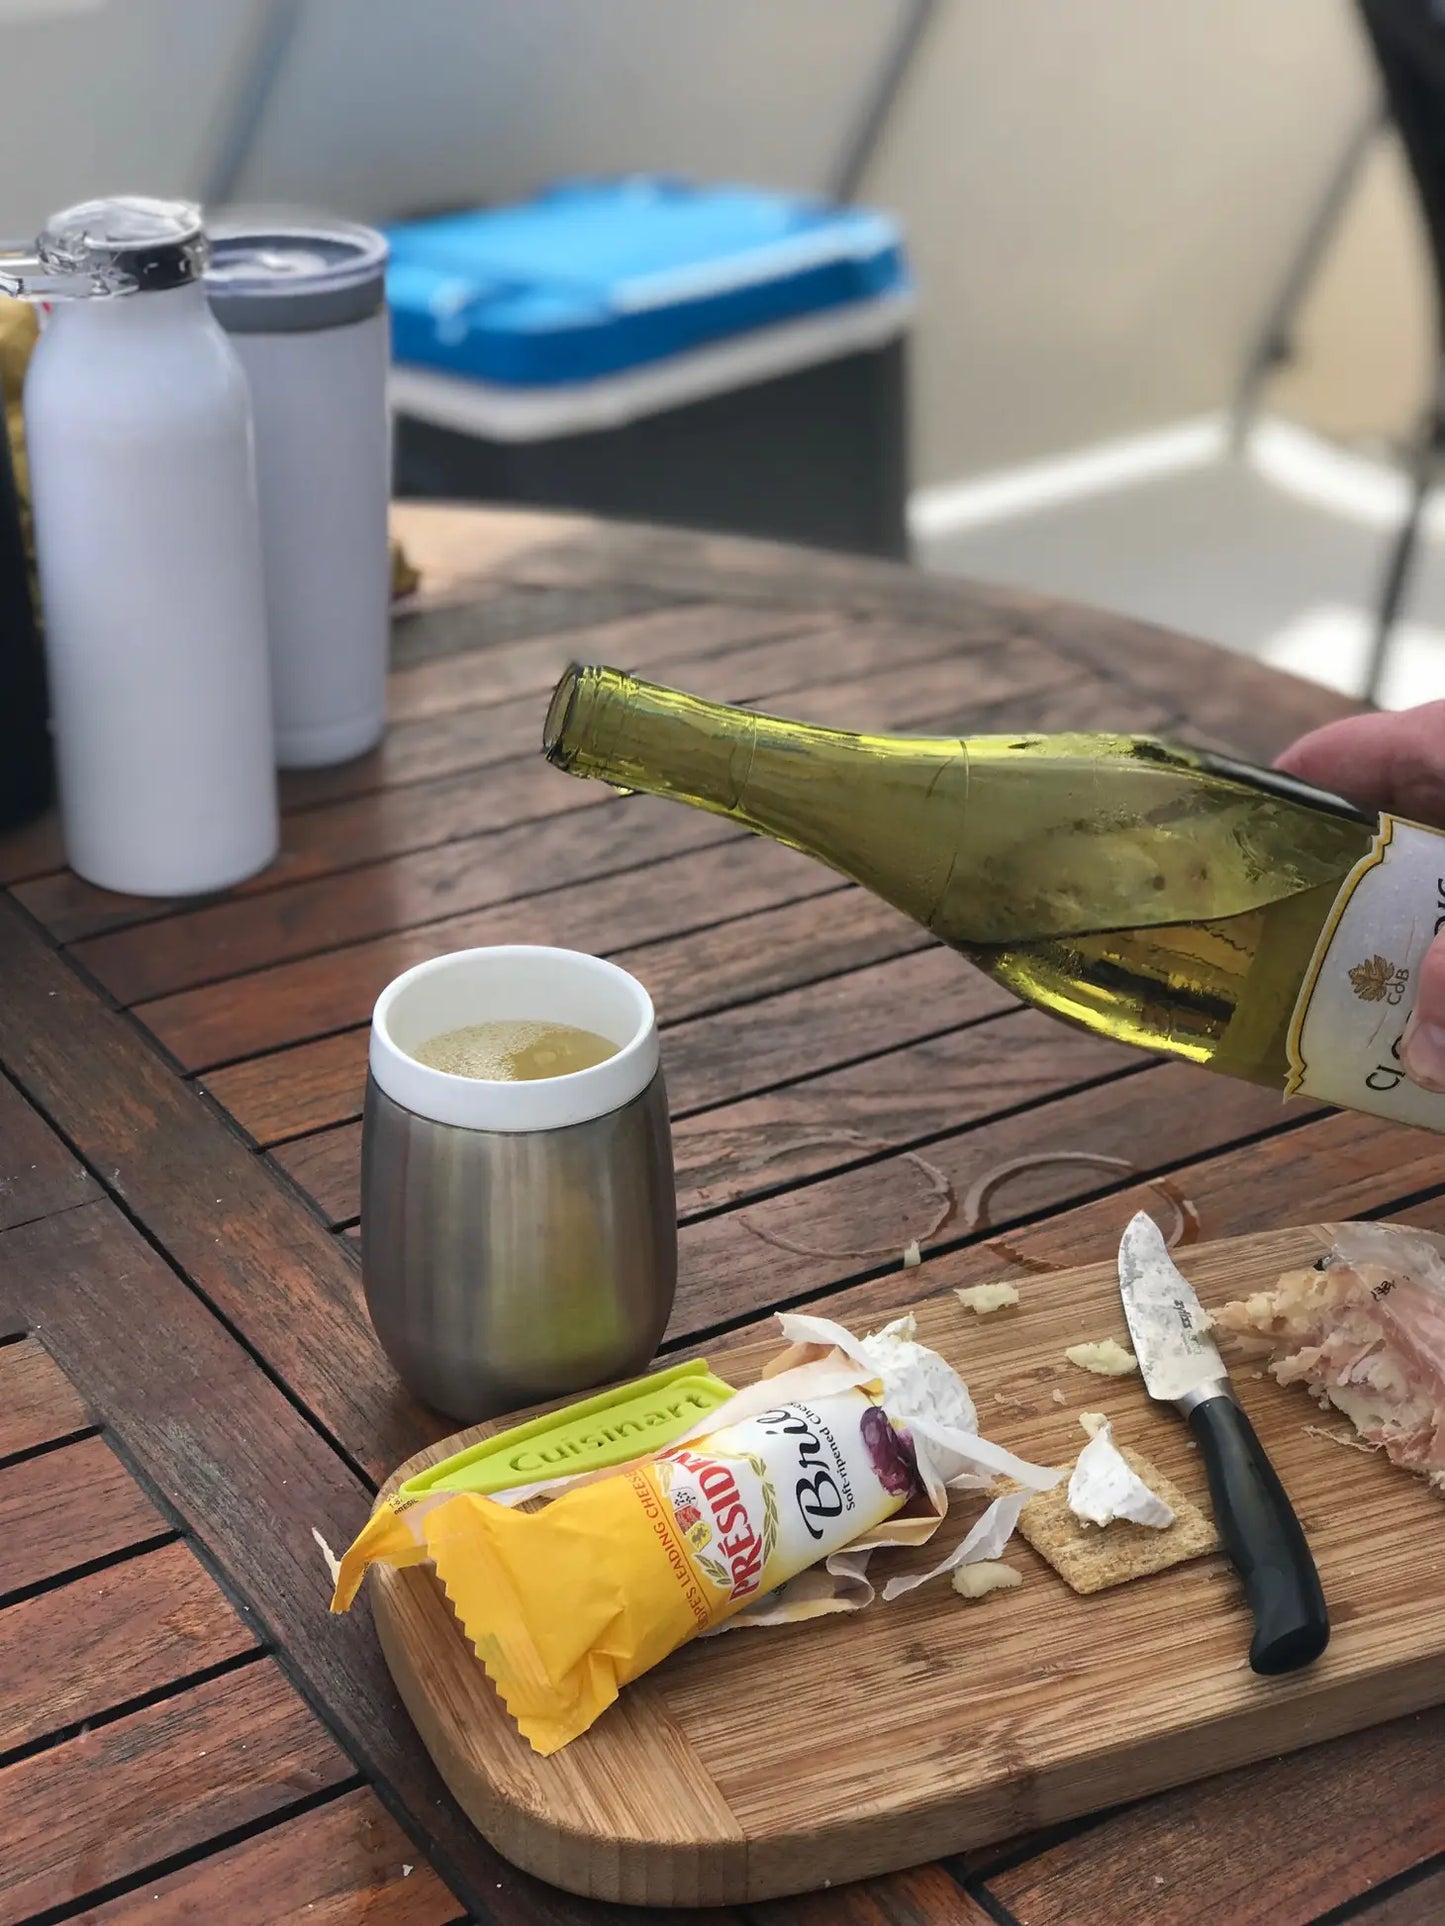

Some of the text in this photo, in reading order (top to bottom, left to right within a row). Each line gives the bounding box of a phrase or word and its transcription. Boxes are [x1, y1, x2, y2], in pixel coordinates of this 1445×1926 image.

[1386, 968, 1410, 1006] CdB
[509, 1391, 711, 1473] Cuisinart
[819, 1426, 856, 1511] Soft-ripened
[756, 1409, 843, 1540] Brie
[653, 1450, 763, 1601] PRÉSID
[653, 1521, 692, 1589] LEADING
